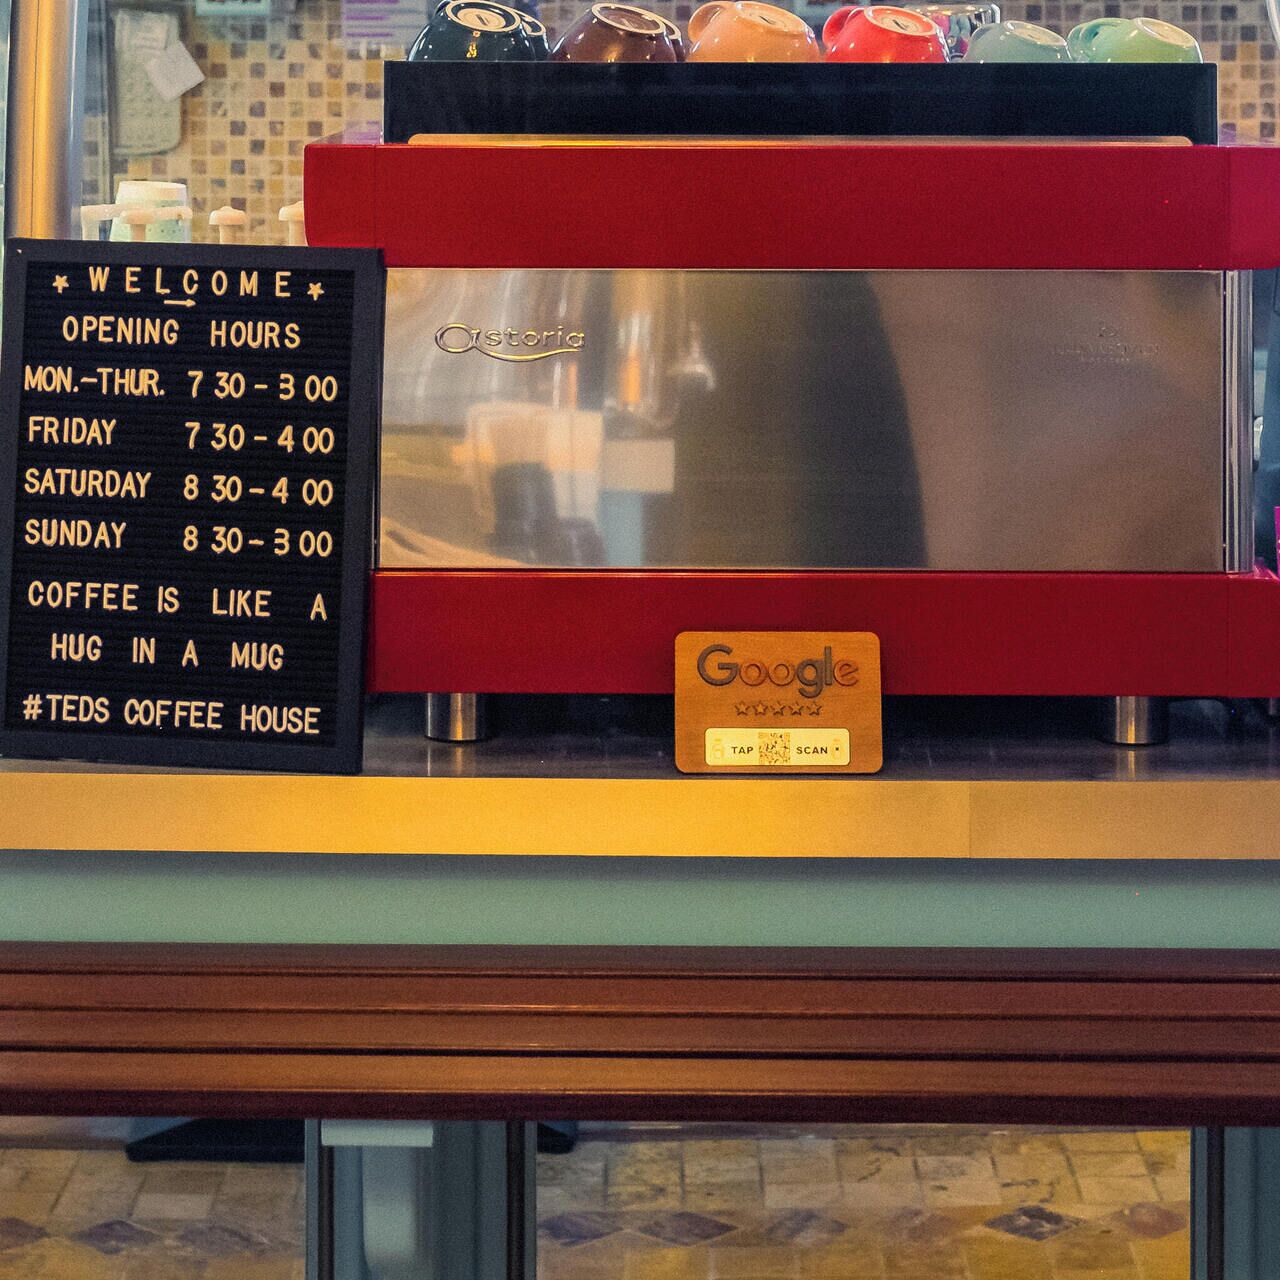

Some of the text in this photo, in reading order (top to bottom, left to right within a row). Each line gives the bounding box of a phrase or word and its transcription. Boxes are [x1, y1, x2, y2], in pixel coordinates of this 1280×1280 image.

[88, 267, 291, 297] WELCOME
[62, 316, 301, 349] OPENING HOURS
[28, 416, 117, 446] FRIDAY
[24, 468, 152, 499] SATURDAY
[24, 518, 126, 549] SUNDAY
[28, 580, 328, 621] COFFEE IS LIKE A
[51, 633, 284, 671] HUG IN A MUG
[696, 644, 859, 698] Google
[23, 693, 321, 734] #TEDS COFFEE HOUSE
[731, 744, 829, 756] TAP SCAN
